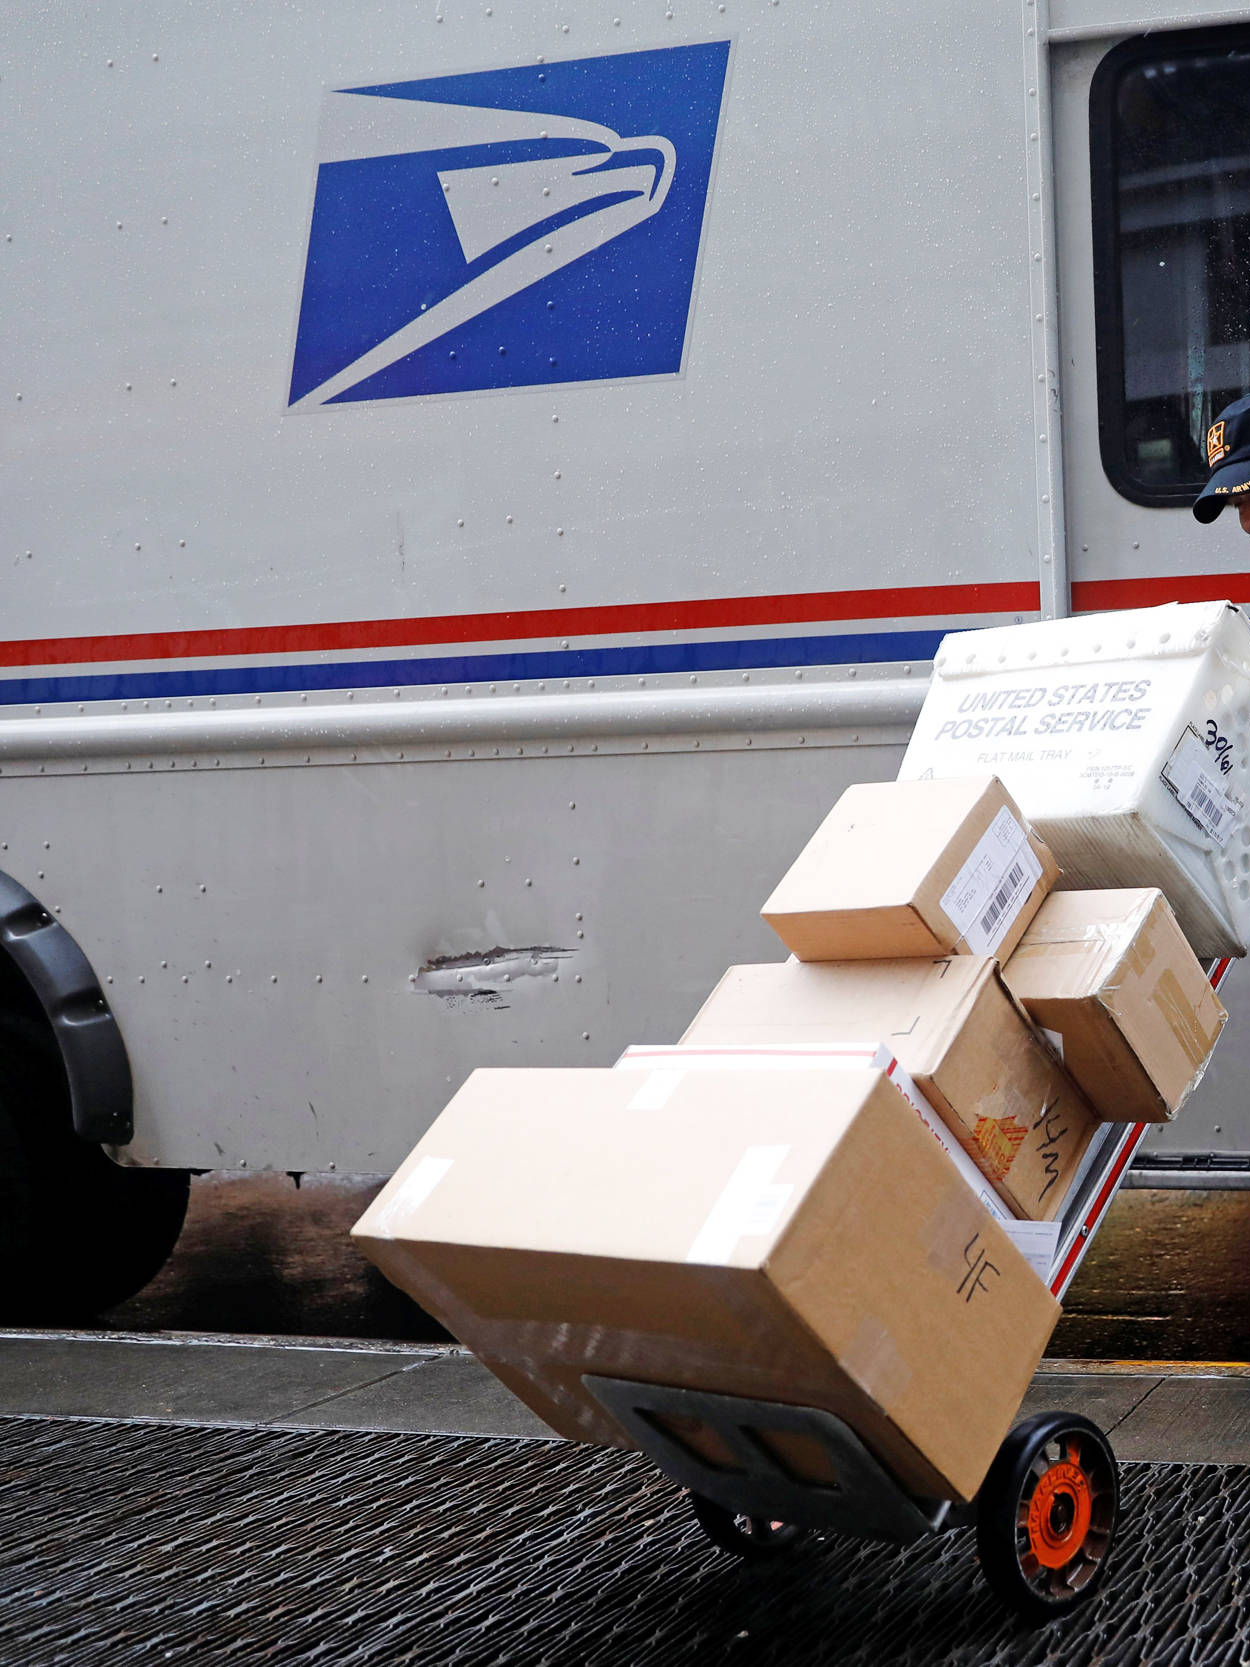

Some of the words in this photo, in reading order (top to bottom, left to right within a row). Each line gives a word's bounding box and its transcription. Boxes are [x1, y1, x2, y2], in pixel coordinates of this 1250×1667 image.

[956, 686, 1047, 714] UNITED
[1047, 679, 1152, 708] STATES
[934, 715, 1028, 741] POSTAL
[1033, 707, 1152, 735] SERVICE
[976, 752, 1007, 764] FLAT
[1007, 751, 1035, 762] MAIL
[1039, 749, 1073, 761] TRAY
